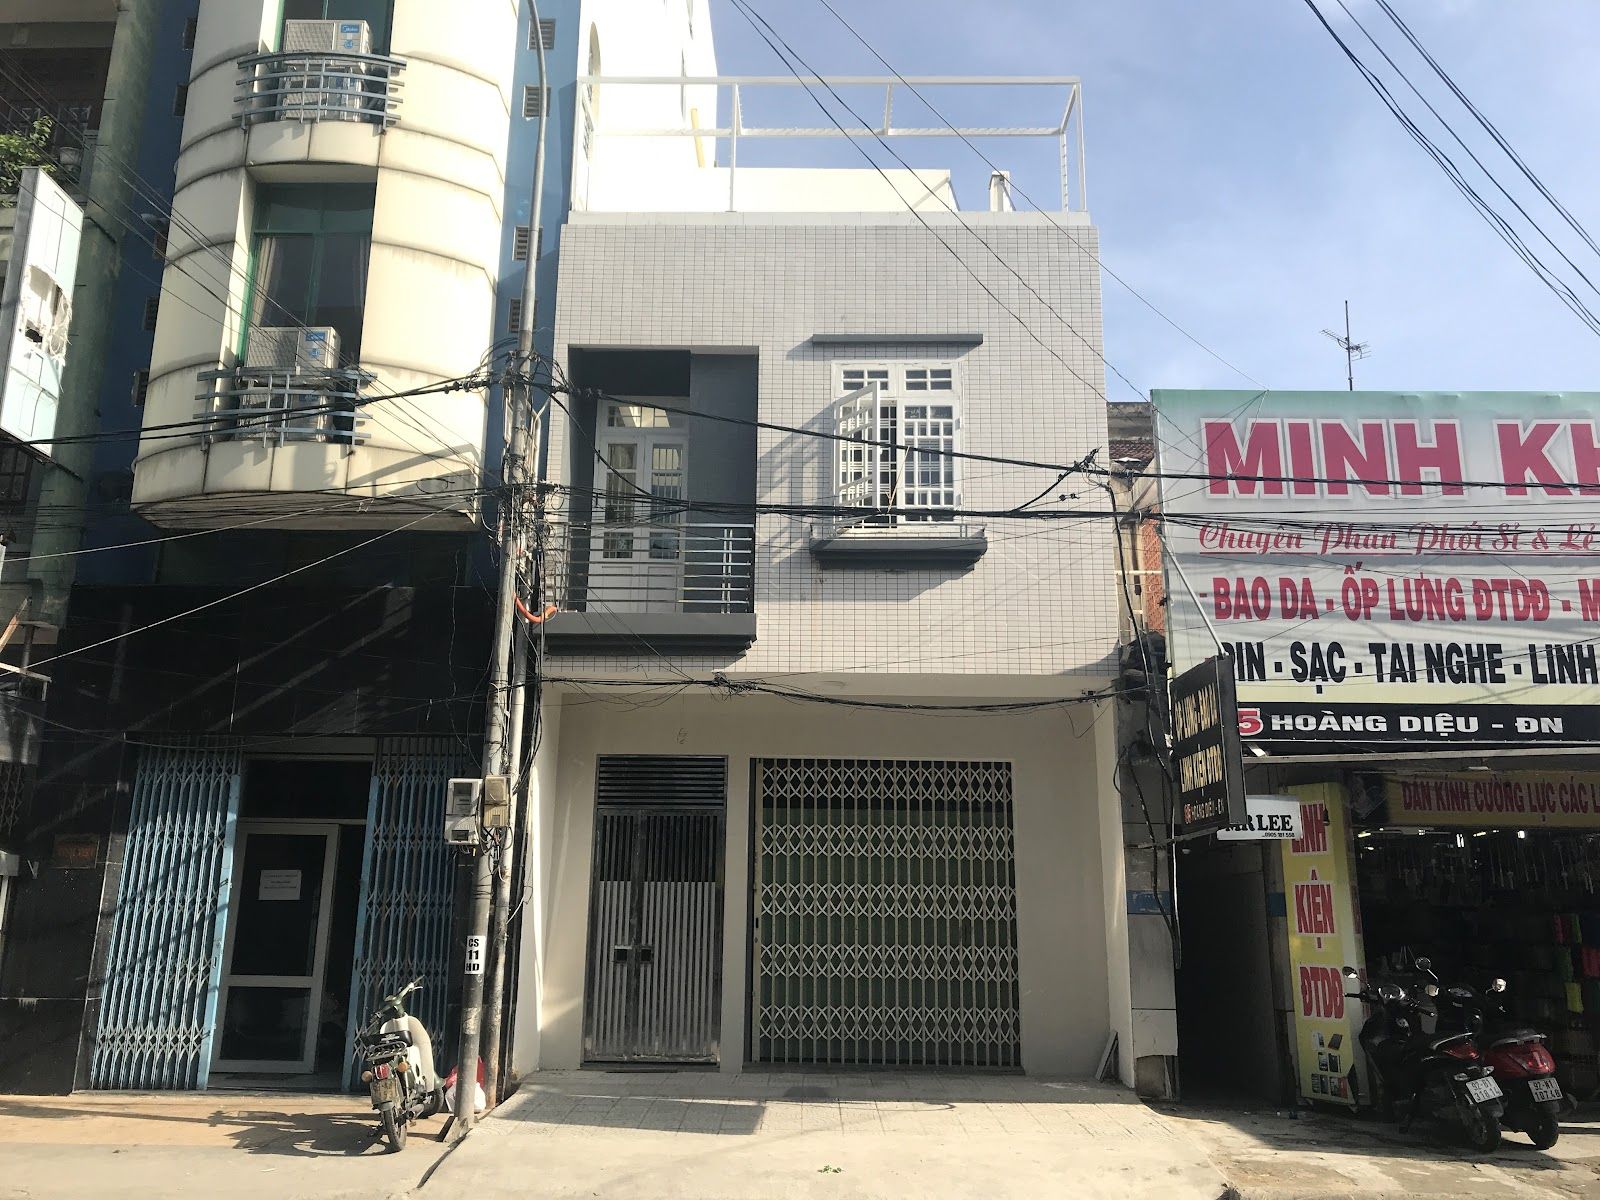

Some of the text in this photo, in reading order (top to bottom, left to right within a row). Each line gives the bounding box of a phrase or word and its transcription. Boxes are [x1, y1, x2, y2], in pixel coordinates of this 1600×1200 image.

[1203, 421, 1466, 497] MINH
[1199, 521, 1304, 555] Chuyên
[1532, 527, 1550, 549] &
[1213, 576, 1272, 621] BAO
[1278, 577, 1320, 620] DA
[1341, 561, 1380, 622] ỐP
[1386, 572, 1466, 622] LƯNG
[1471, 578, 1550, 622] ĐTDĐ
[1290, 641, 1347, 694] SẠC
[1368, 642, 1417, 683] TAI
[1423, 642, 1506, 685] NGHE
[1528, 643, 1599, 684] LINH
[1271, 710, 1387, 732] HOÀNG
[1399, 712, 1479, 737] DIỆU
[1514, 716, 1564, 734] ĐN
[1256, 814, 1294, 832] LEE
[1295, 869, 1335, 949] KIỆN
[468, 938, 480, 947] CS
[468, 949, 479, 960] 11
[1300, 966, 1345, 1019] ĐTDĐ
